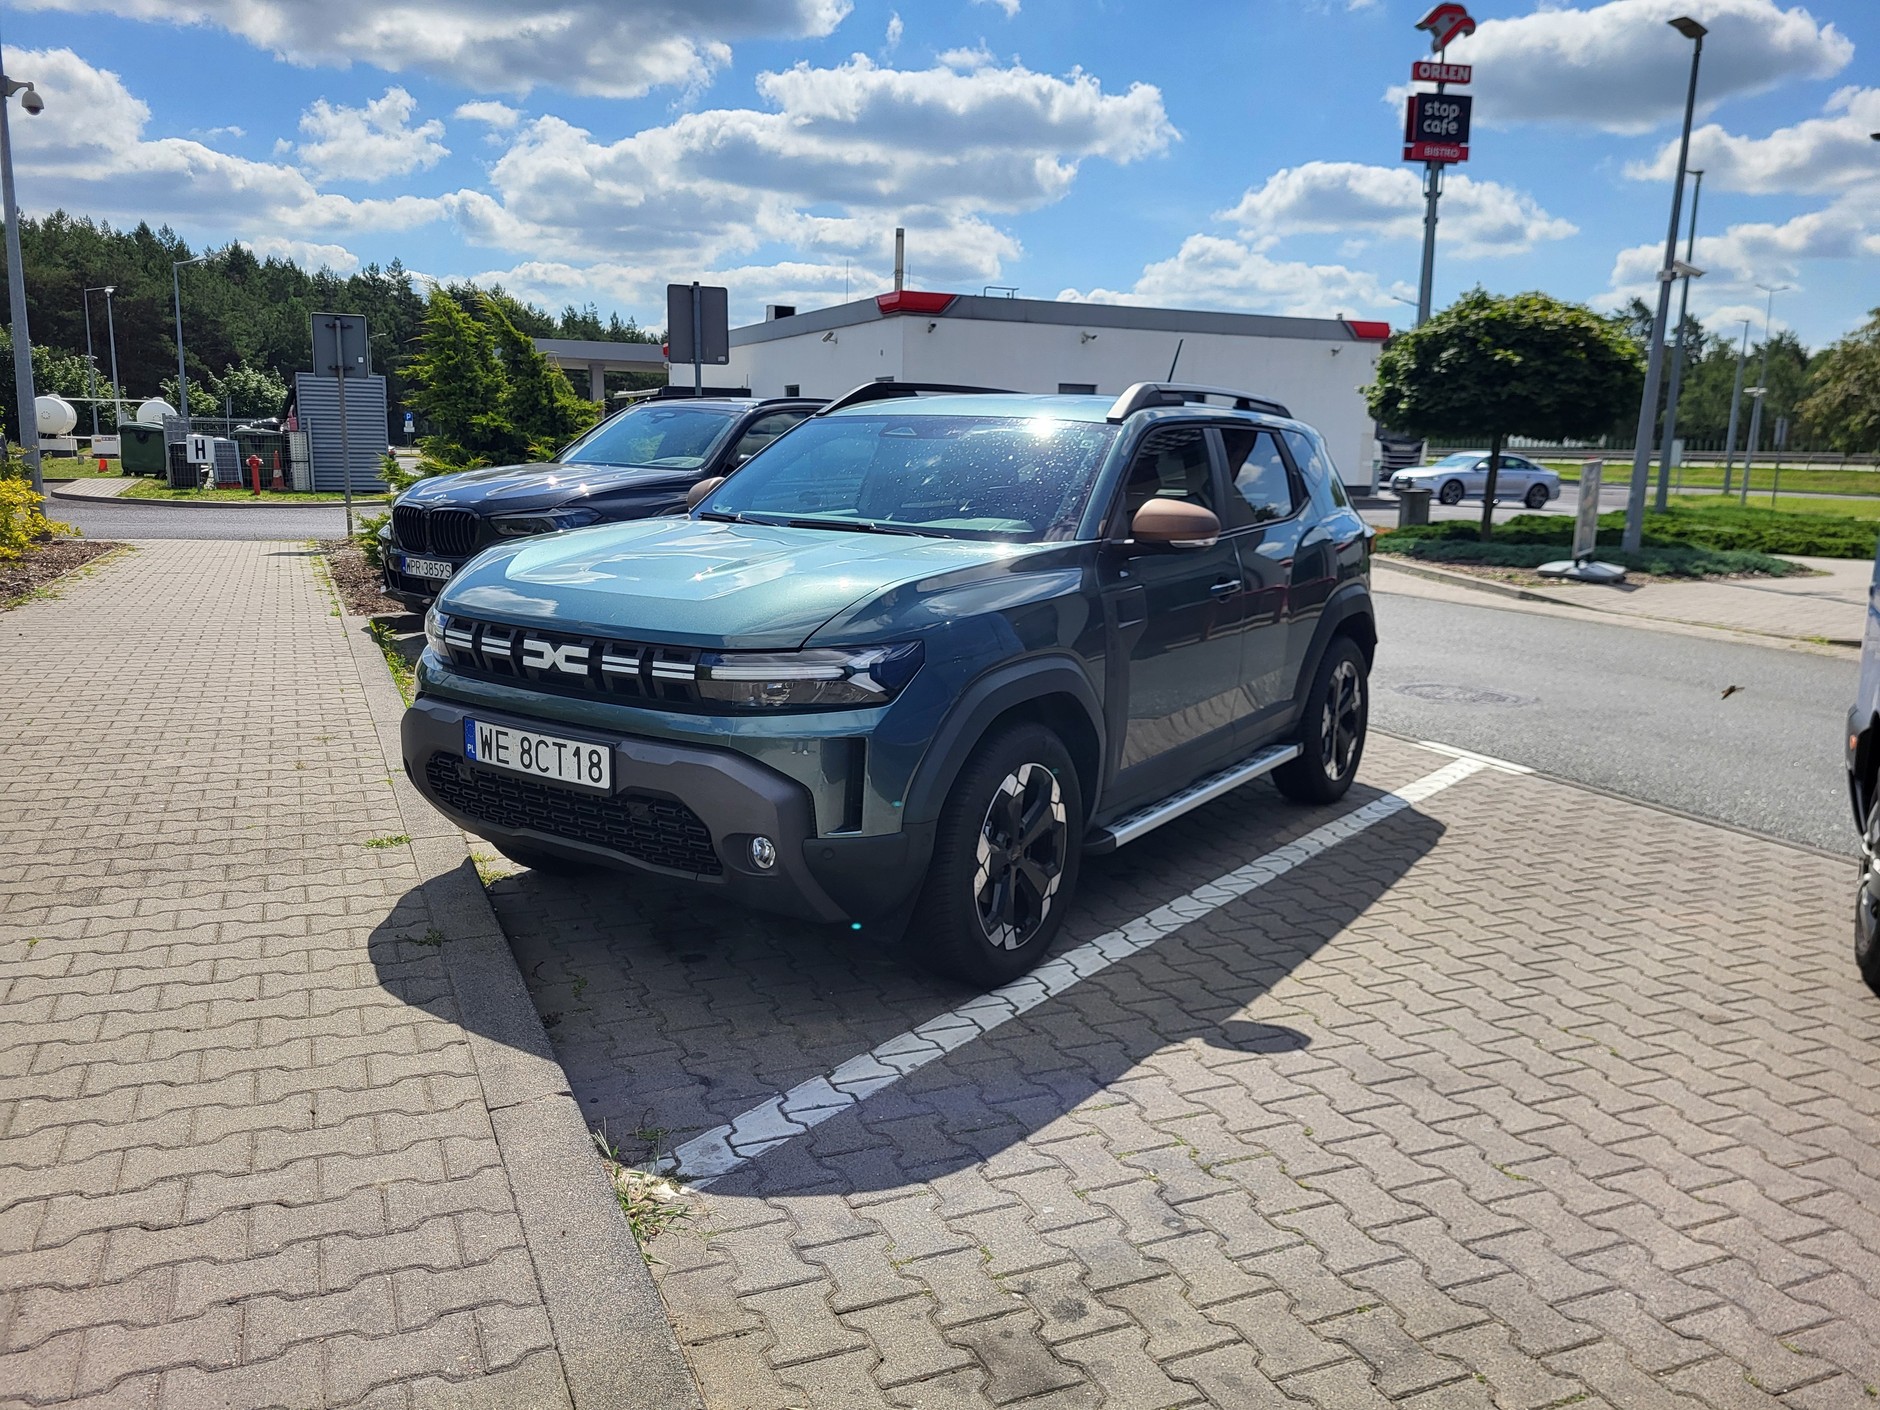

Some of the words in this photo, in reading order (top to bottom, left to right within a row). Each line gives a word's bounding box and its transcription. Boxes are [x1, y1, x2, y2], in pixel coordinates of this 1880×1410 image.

[1418, 65, 1470, 81] ORLEN
[1423, 101, 1460, 120] stop
[1422, 118, 1459, 136] cafe
[1424, 145, 1460, 158] BISTRO
[195, 439, 206, 460] H
[424, 562, 451, 578] 3859S
[467, 743, 476, 754] PL
[479, 726, 510, 765] WE
[519, 736, 603, 784] 8CT18
